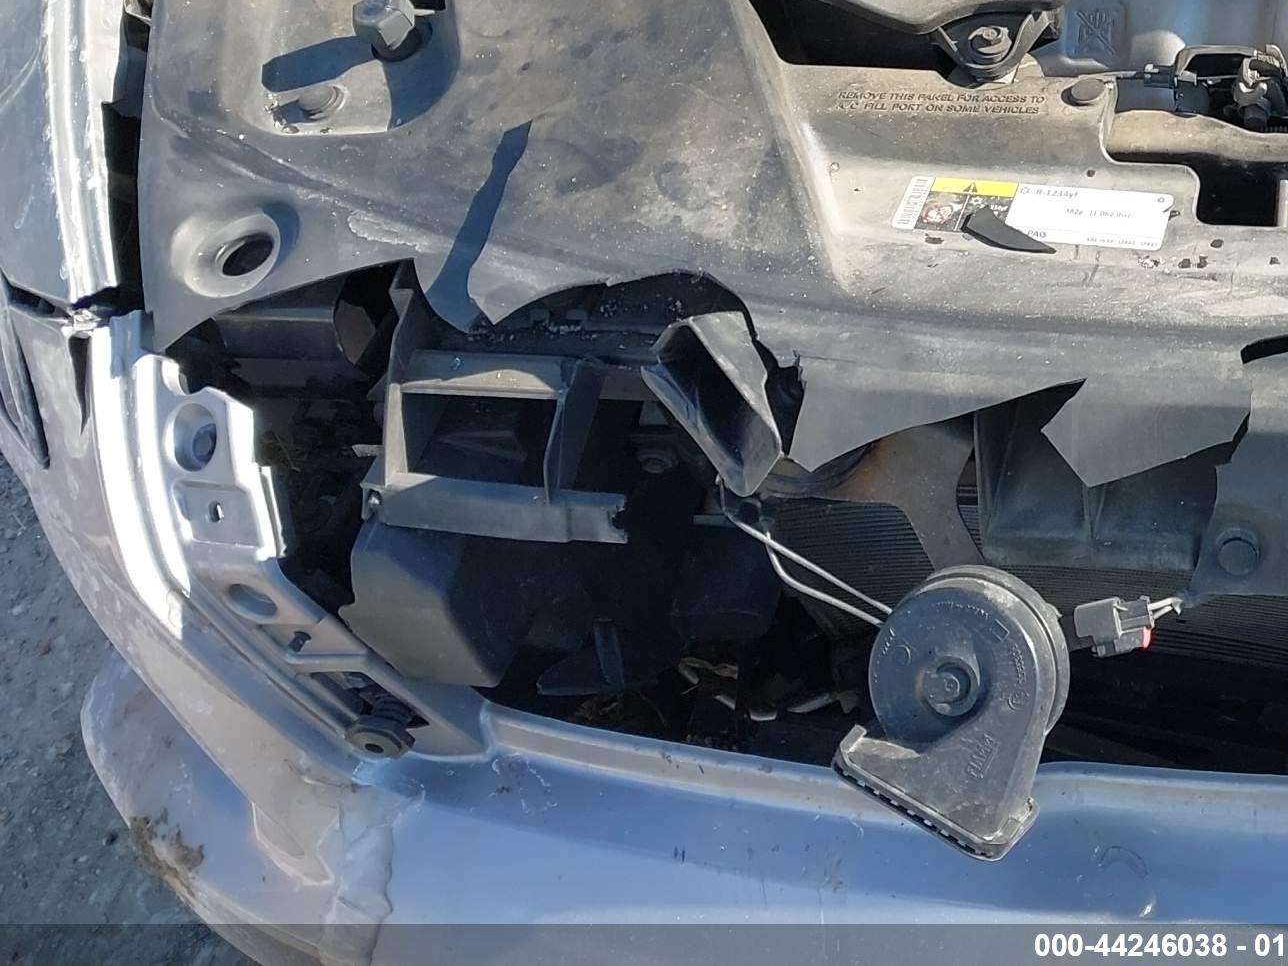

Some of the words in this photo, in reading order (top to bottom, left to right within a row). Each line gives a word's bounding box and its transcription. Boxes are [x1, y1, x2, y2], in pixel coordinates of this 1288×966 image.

[838, 91, 886, 100] REMOVE
[889, 92, 914, 101] THIS
[917, 93, 955, 102] PANEL
[956, 94, 981, 103] FOR
[981, 94, 1027, 103] ACCESS
[1030, 95, 1046, 104] TO
[864, 102, 887, 111] FILL
[891, 103, 922, 112] PORT
[925, 104, 944, 113] ON
[946, 104, 980, 114] SOME
[984, 105, 1040, 115] VEHICLES
